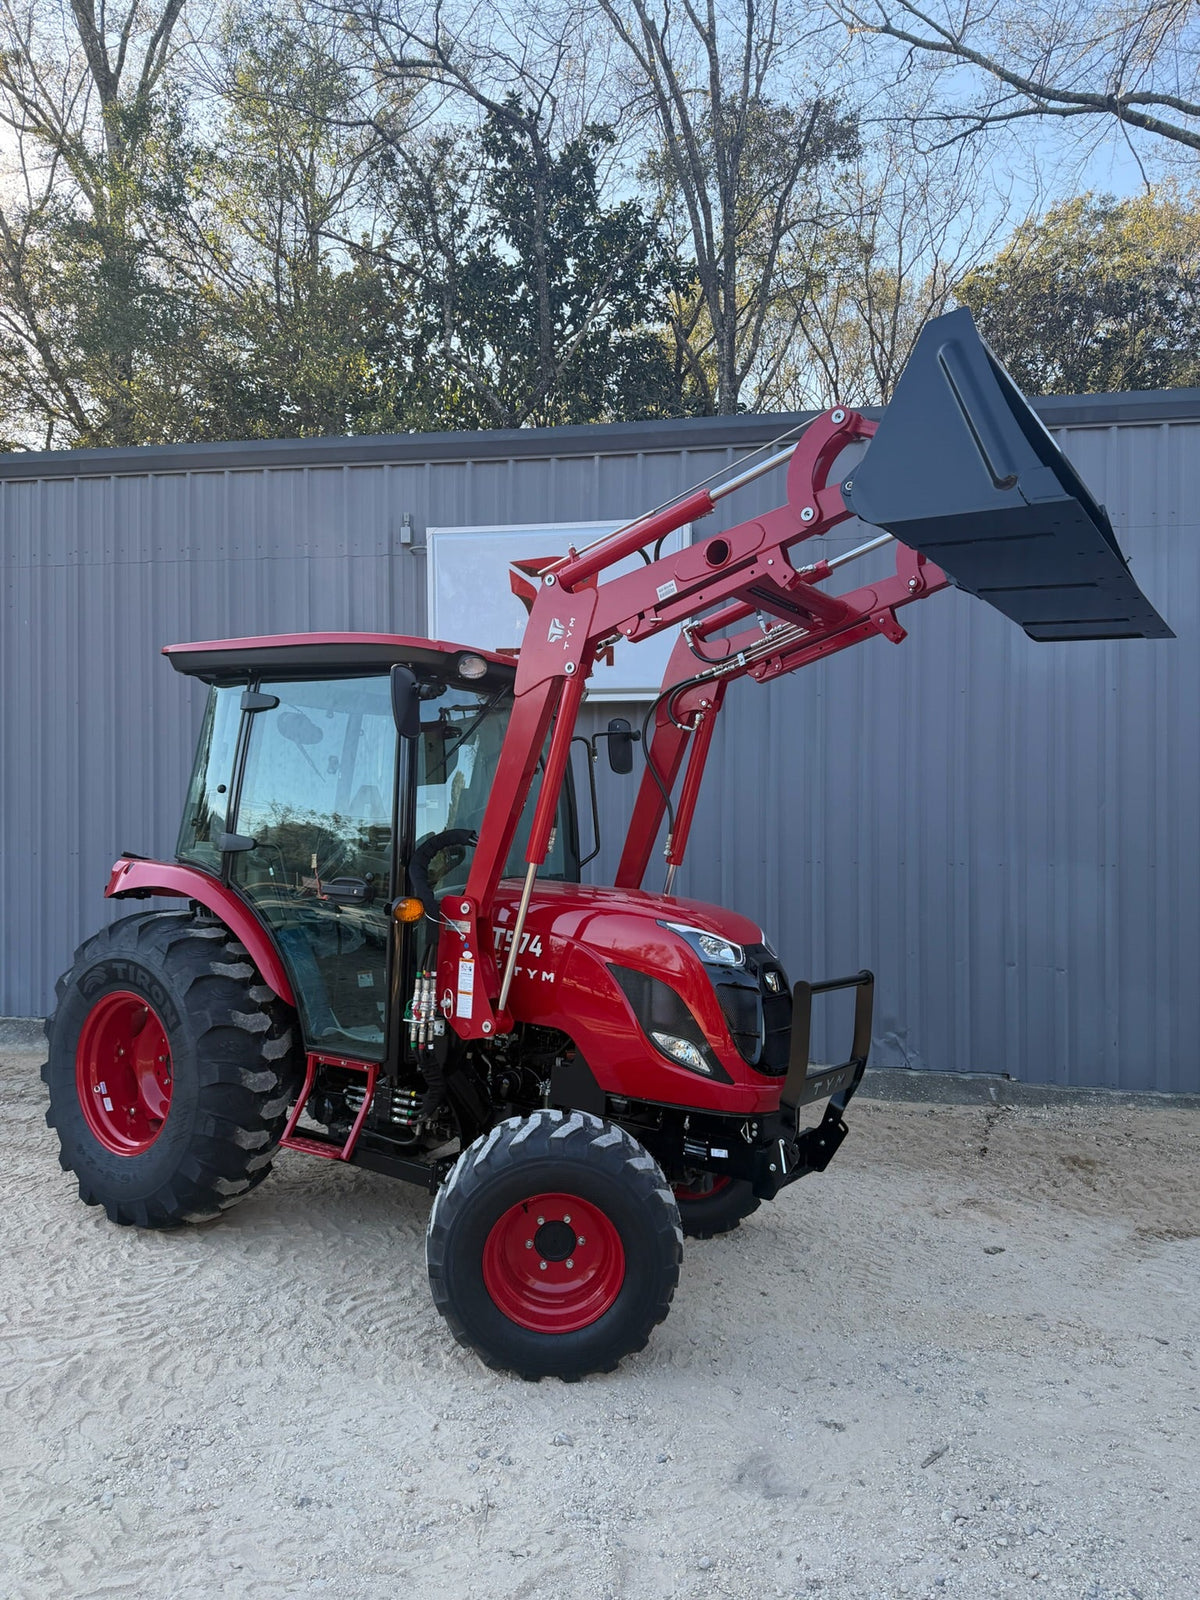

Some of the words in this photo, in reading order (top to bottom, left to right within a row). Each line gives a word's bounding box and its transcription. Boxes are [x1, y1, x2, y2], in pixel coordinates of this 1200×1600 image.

[563, 617, 576, 650] TYM
[492, 926, 543, 958] T574
[514, 966, 555, 983] TYM
